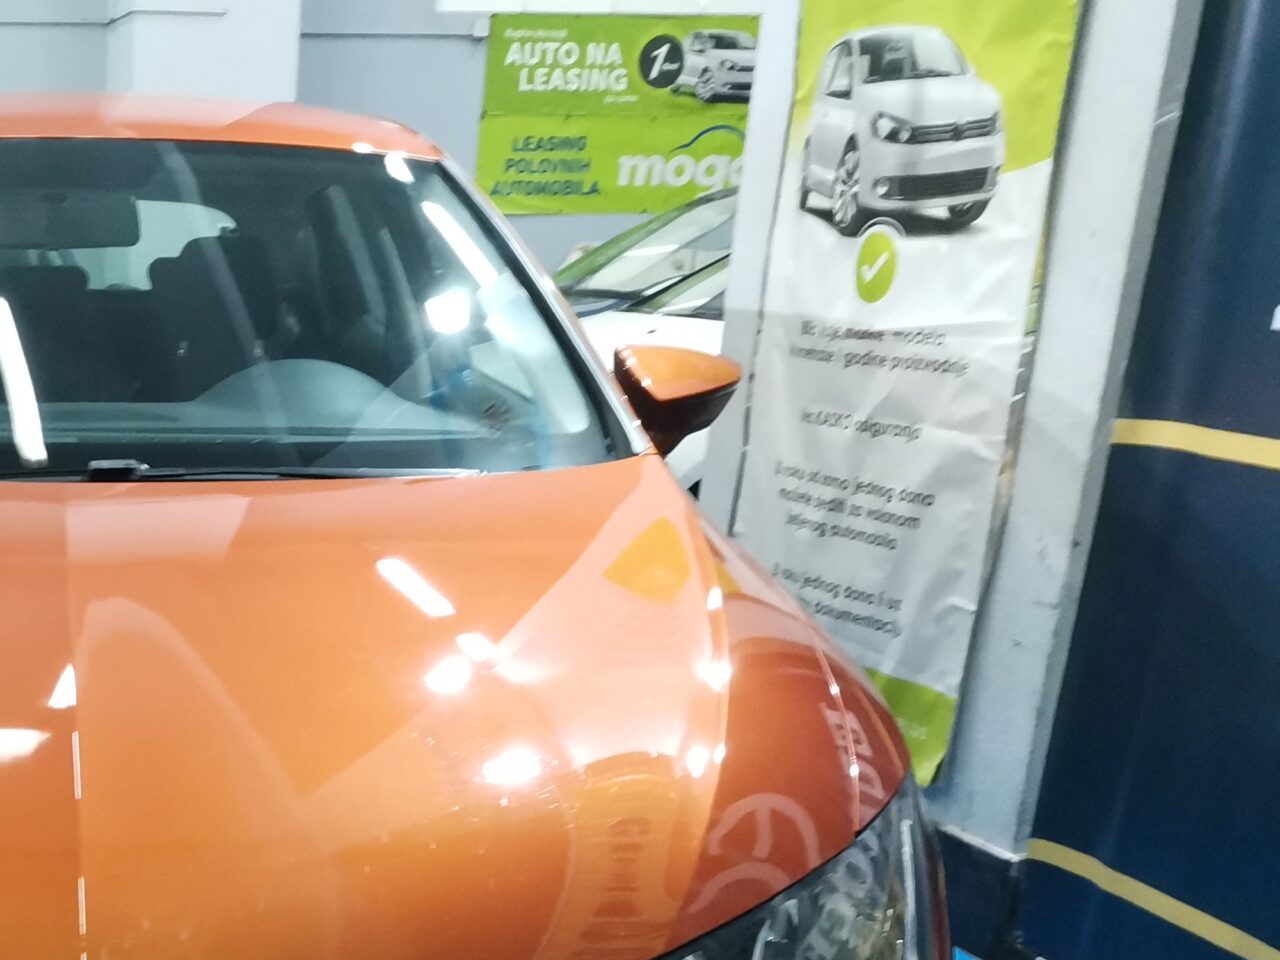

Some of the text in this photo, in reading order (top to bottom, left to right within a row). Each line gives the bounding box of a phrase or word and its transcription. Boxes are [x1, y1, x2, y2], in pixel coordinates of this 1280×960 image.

[504, 42, 622, 66] AUTO NA
[518, 67, 628, 91] LEASING
[512, 135, 588, 152] LEASING
[504, 158, 591, 174] POLOVNIH
[490, 180, 600, 196] AUTOMOBILA
